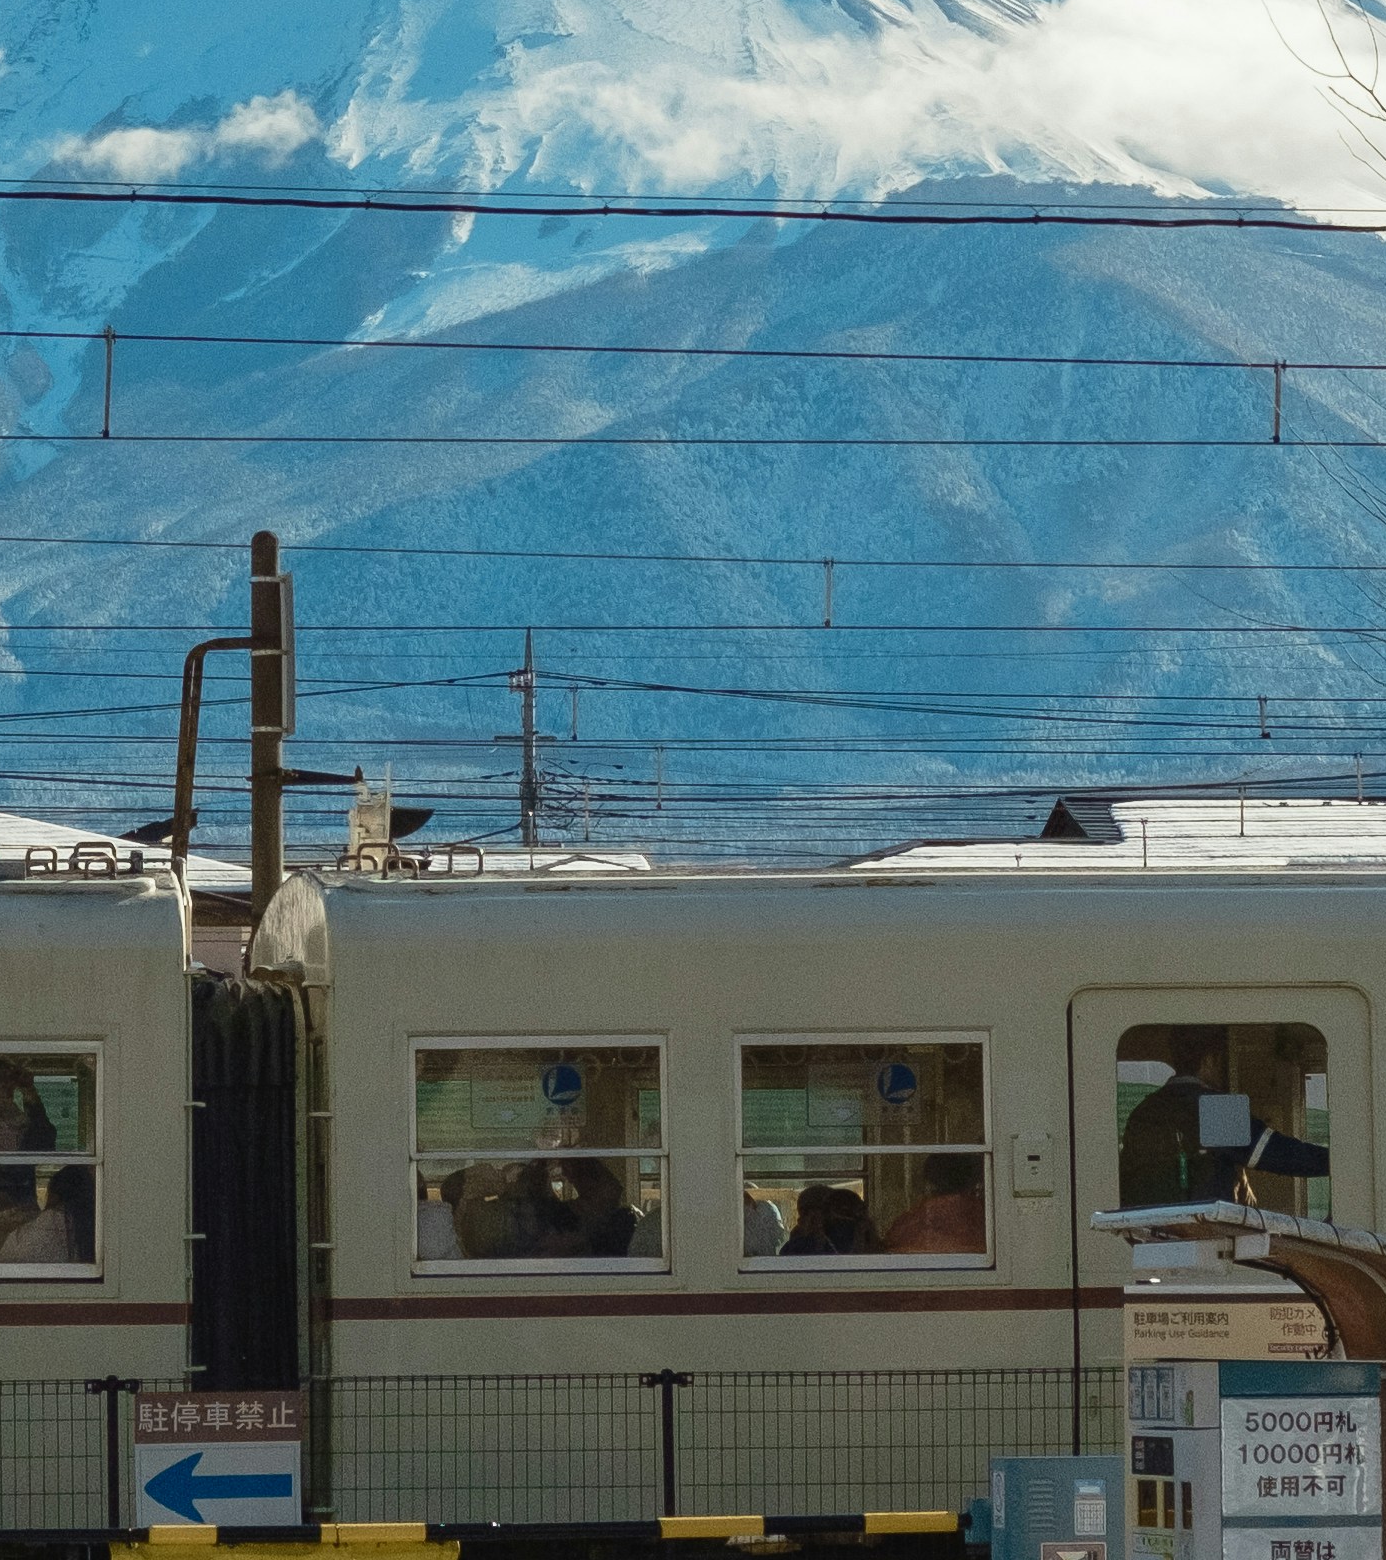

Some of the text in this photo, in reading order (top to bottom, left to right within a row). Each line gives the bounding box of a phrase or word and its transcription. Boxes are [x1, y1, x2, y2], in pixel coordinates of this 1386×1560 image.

[1133, 1311, 1229, 1326] 駐車場ご利用案内
[1281, 1323, 1317, 1336] 作動中
[1134, 1328, 1229, 1340] Parking Use Guidance
[138, 1400, 297, 1433] 駐停車禁止
[1245, 1411, 1357, 1433] 5000円札
[1239, 1442, 1365, 1465] 10000円札
[1256, 1475, 1346, 1498] 使用不可
